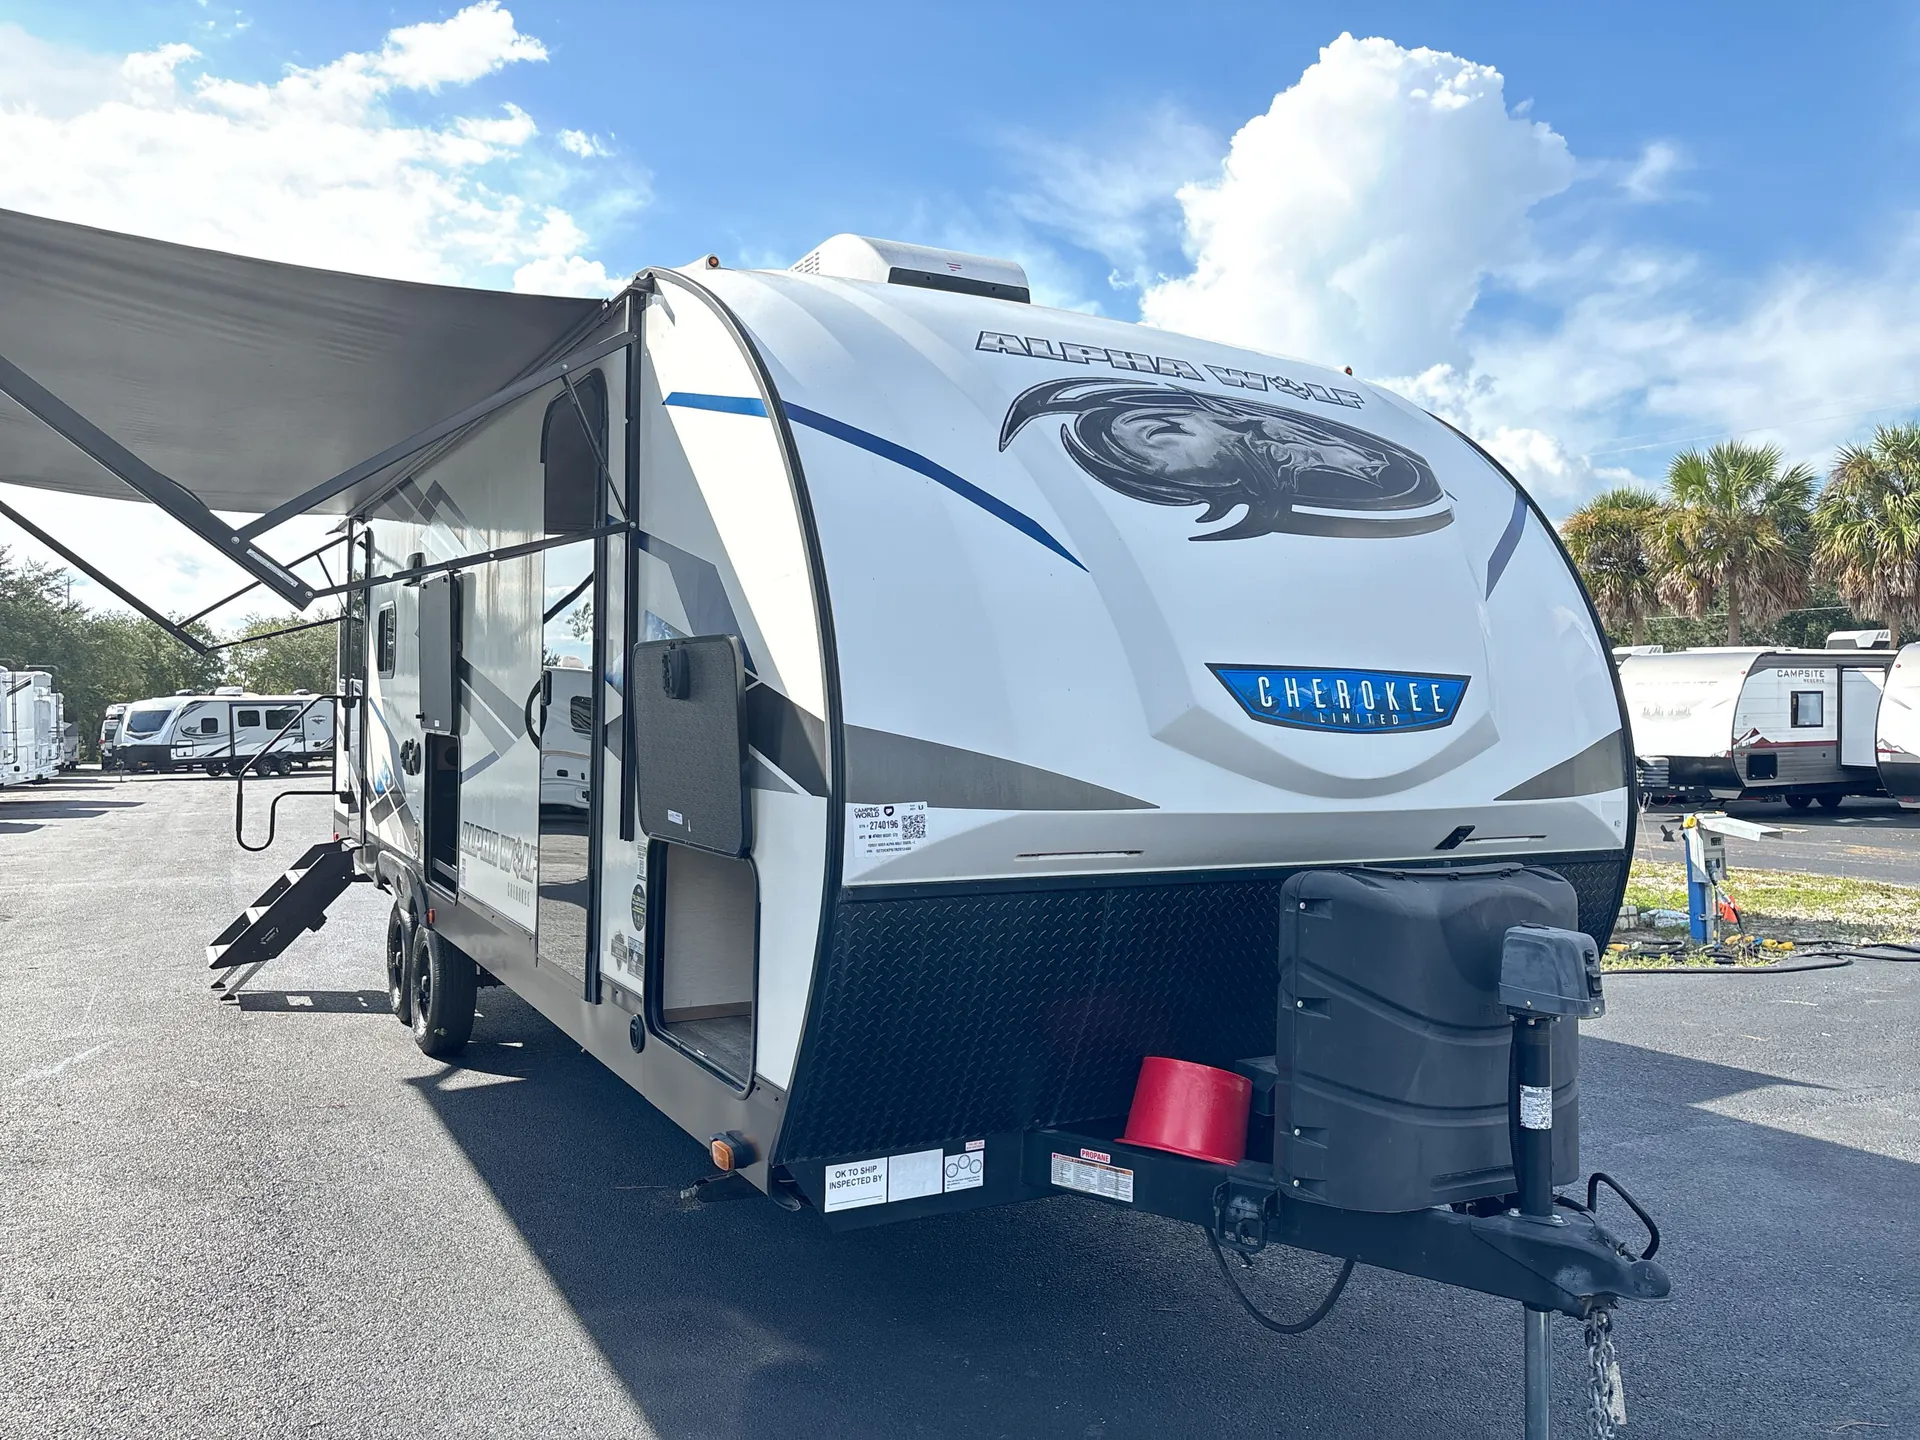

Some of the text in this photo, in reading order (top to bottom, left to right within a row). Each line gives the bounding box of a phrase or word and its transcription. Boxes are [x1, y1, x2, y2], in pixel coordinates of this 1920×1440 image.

[975, 330, 1206, 382] ALPHA
[1777, 669, 1825, 678] CAMPSITE
[1257, 676, 1445, 713] CHEROKEE
[1319, 712, 1399, 725] LIMITED
[870, 820, 898, 830] 2740196
[1081, 1149, 1109, 1163] PROPANE
[835, 1164, 878, 1179] OK TO SHIP
[828, 1173, 883, 1190] INSPECTED BY
